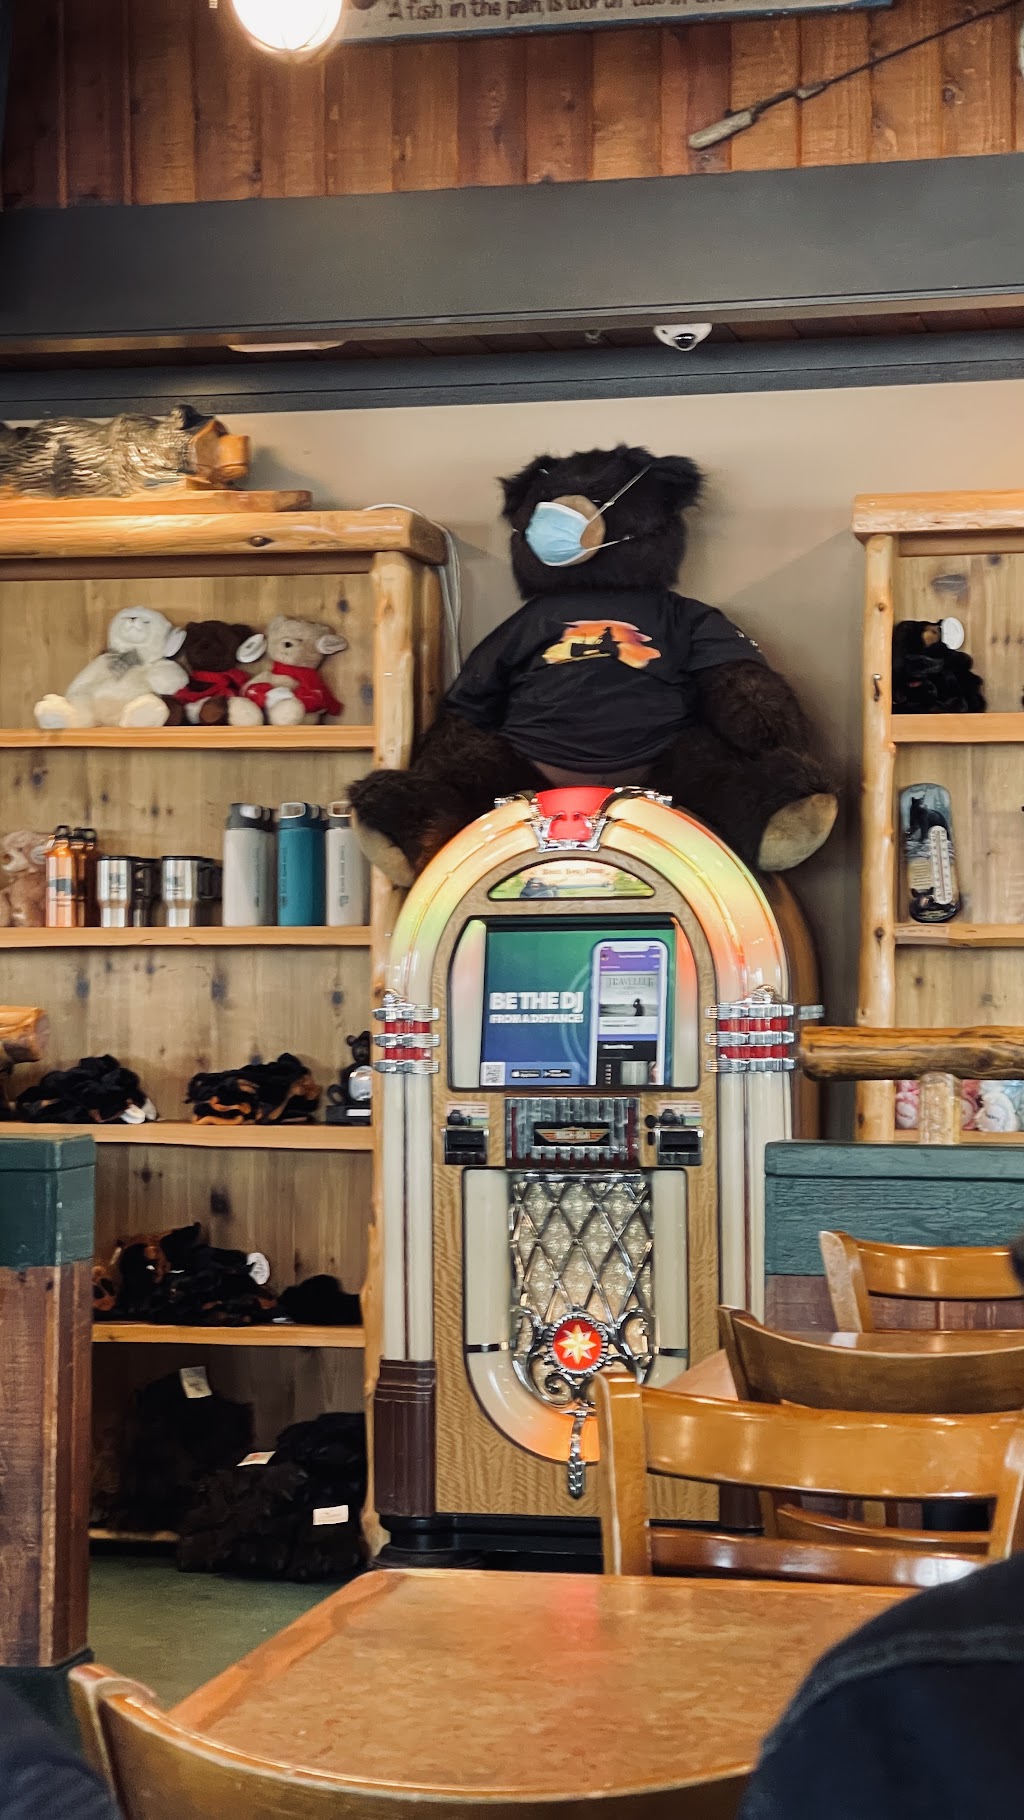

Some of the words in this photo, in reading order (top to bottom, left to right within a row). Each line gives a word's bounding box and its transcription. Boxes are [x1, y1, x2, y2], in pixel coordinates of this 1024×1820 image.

[406, 0, 443, 20] fish
[449, 2, 466, 18] in
[470, 0, 500, 17] the
[489, 992, 518, 1010] BE
[519, 992, 560, 1010] THE
[560, 992, 584, 1013] DJ
[489, 1014, 521, 1024] FROM
[521, 1014, 530, 1024] A
